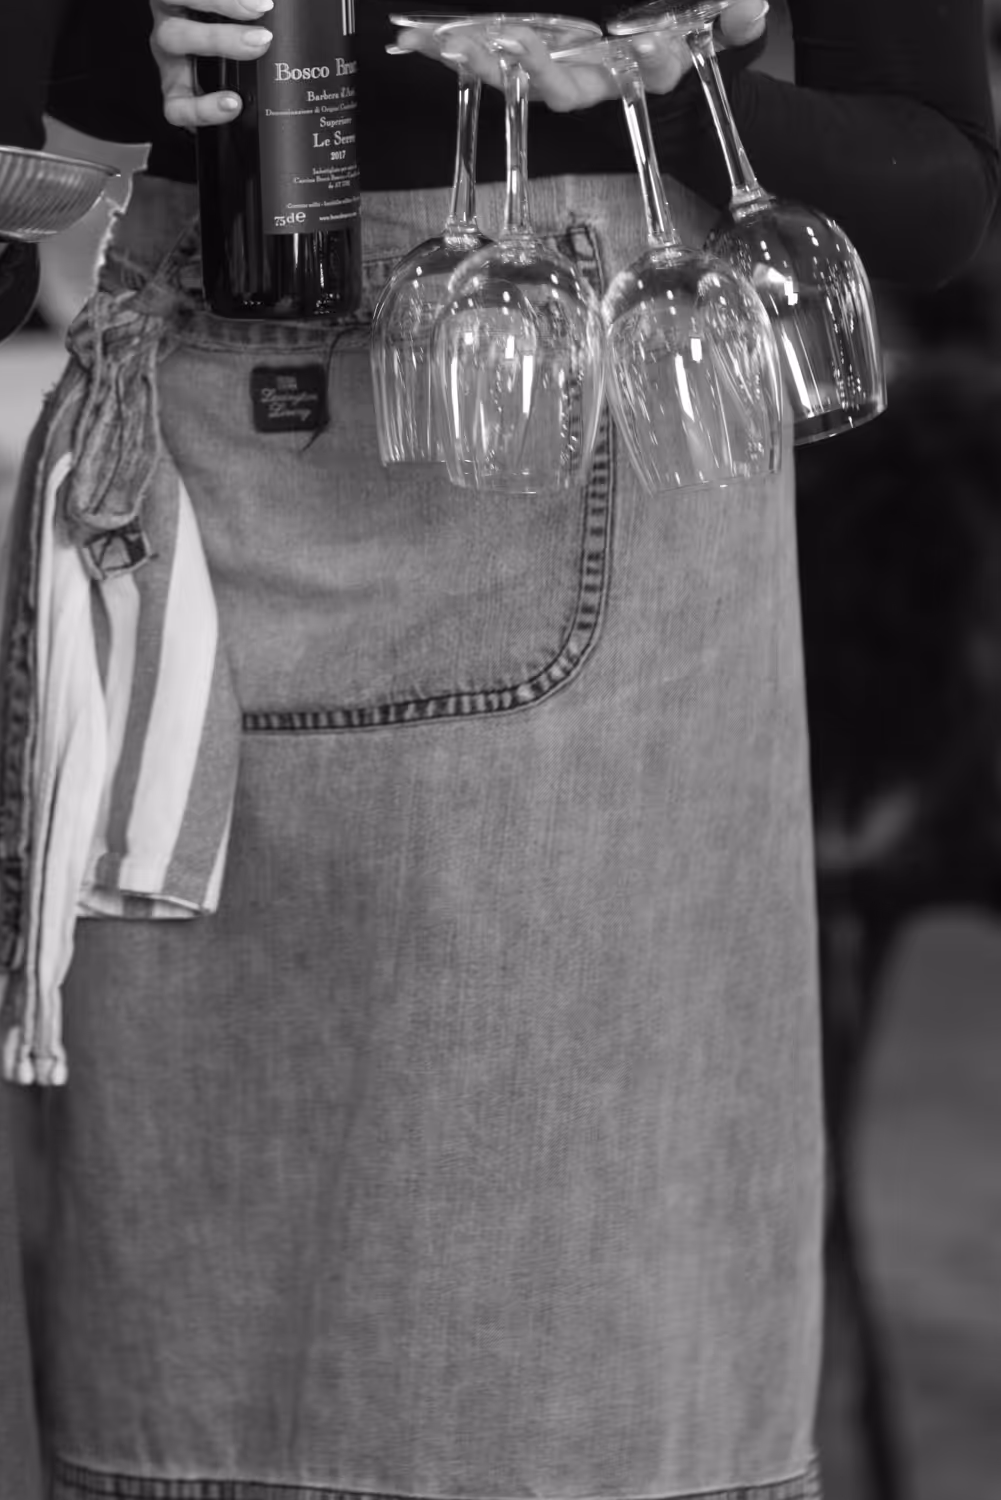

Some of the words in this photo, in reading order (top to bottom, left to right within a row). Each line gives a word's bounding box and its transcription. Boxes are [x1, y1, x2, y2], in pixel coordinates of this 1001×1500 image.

[274, 62, 330, 81] Bosco
[312, 132, 331, 148] Le
[330, 149, 346, 161] 2017
